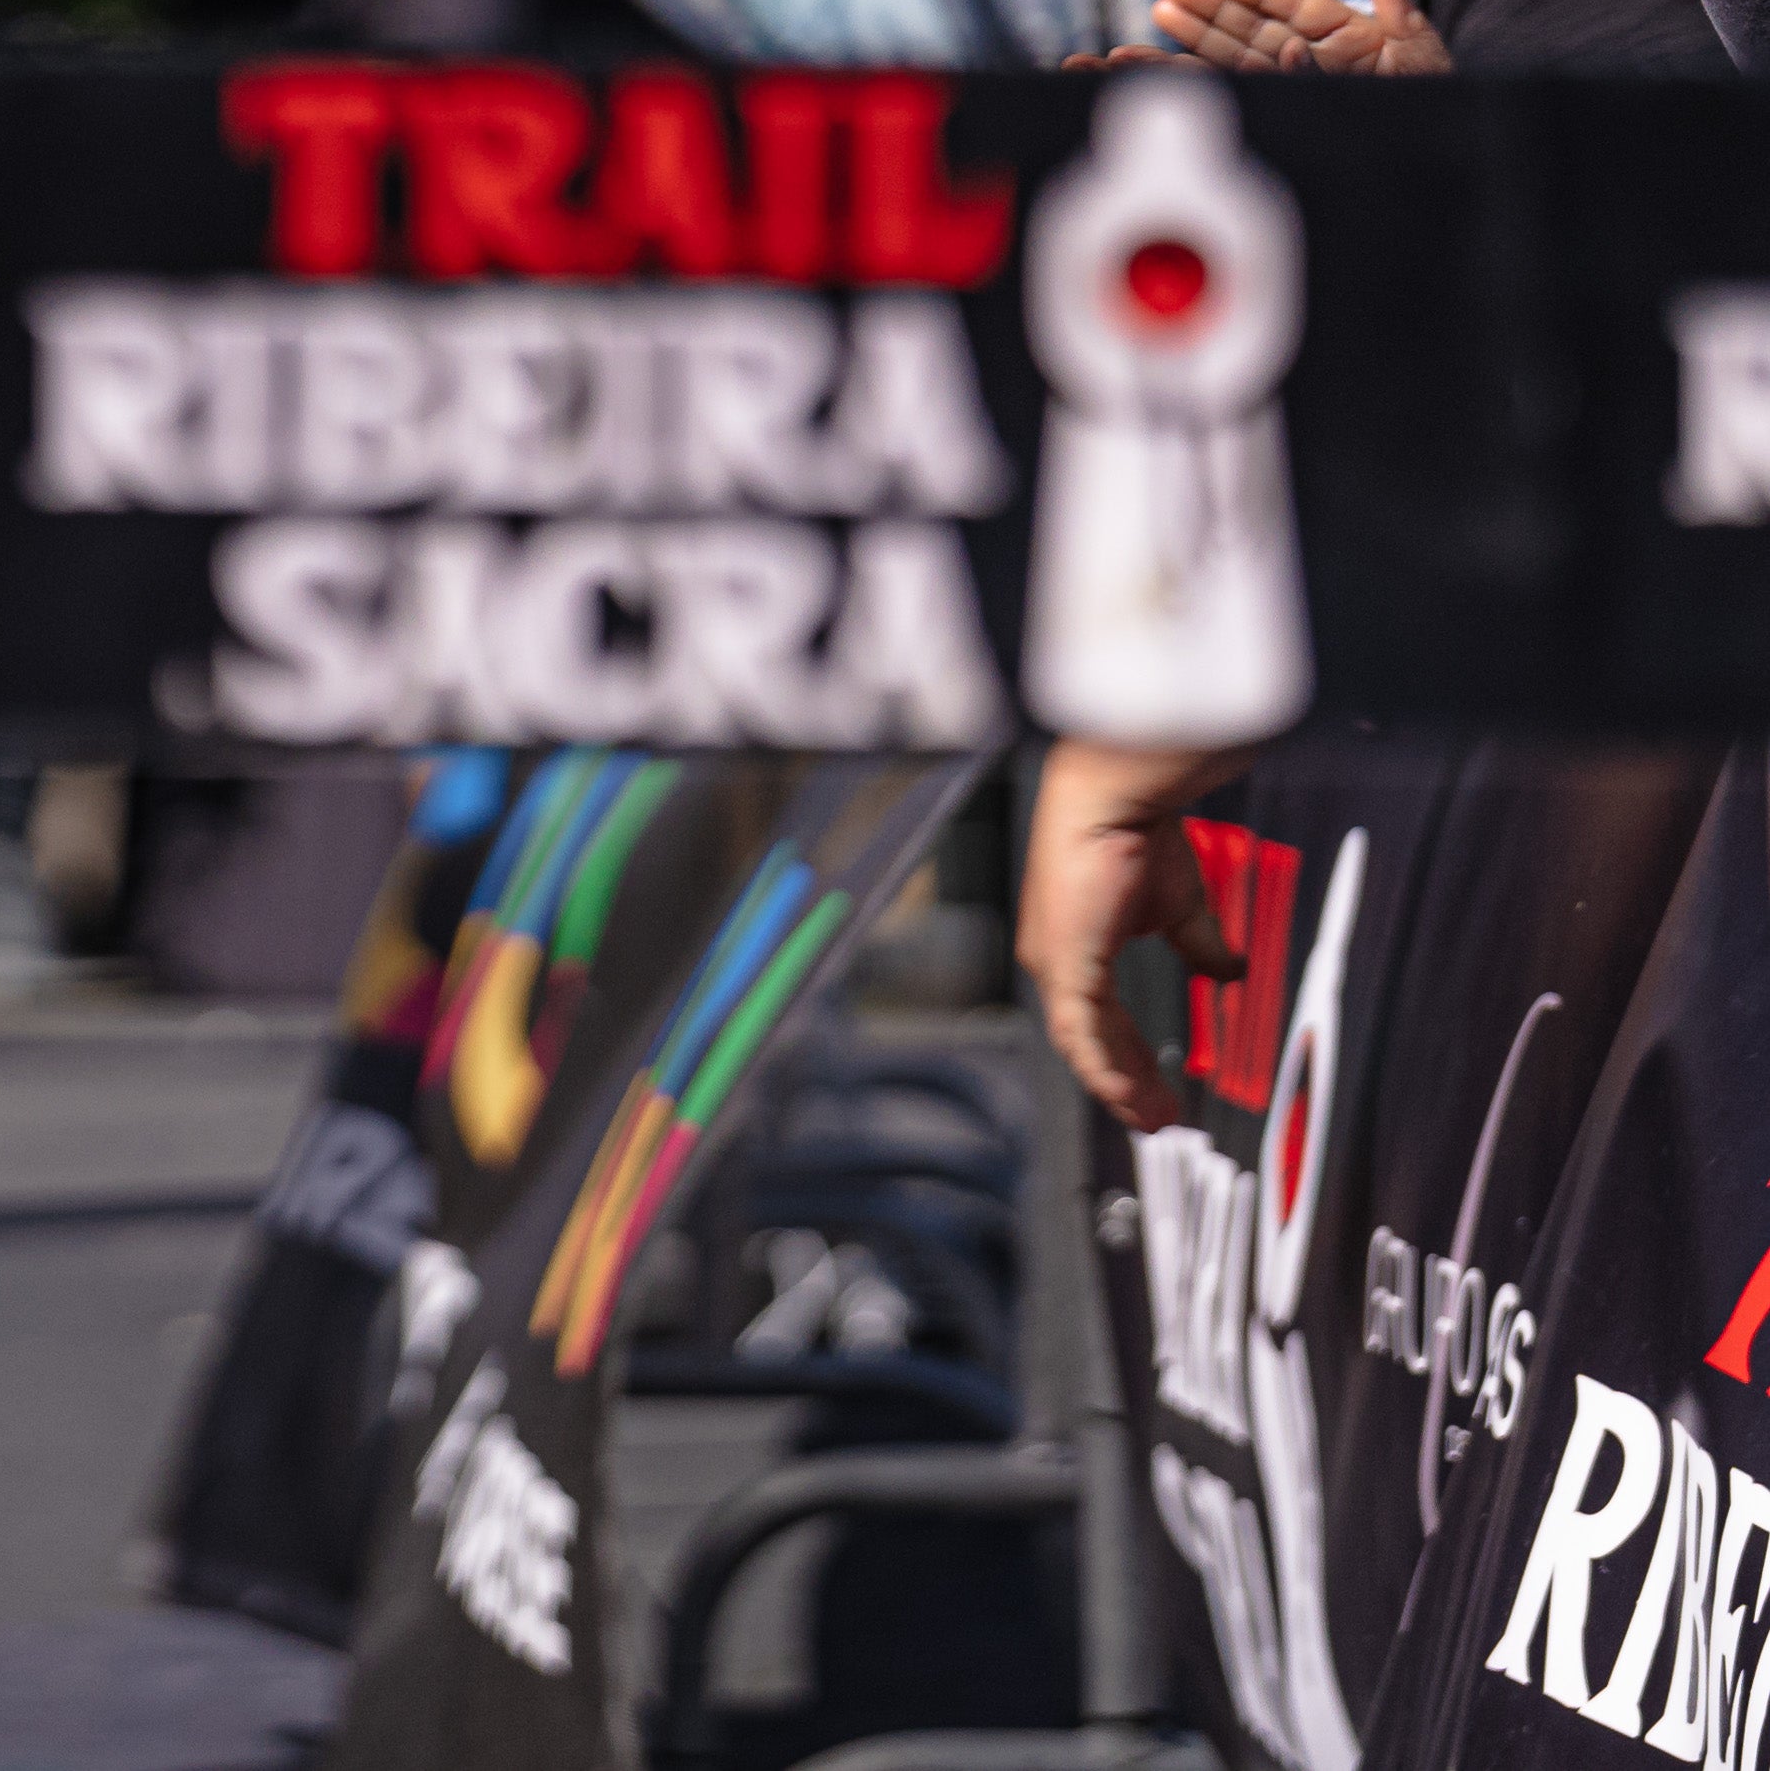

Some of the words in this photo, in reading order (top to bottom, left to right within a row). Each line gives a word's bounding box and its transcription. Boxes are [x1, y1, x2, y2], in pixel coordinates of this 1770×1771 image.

[224, 65, 1013, 287] TRAIL
[18, 278, 1013, 515] RIBEIRA
[211, 515, 1013, 742] SACRA
[1484, 1373, 1770, 1771] RIBE
